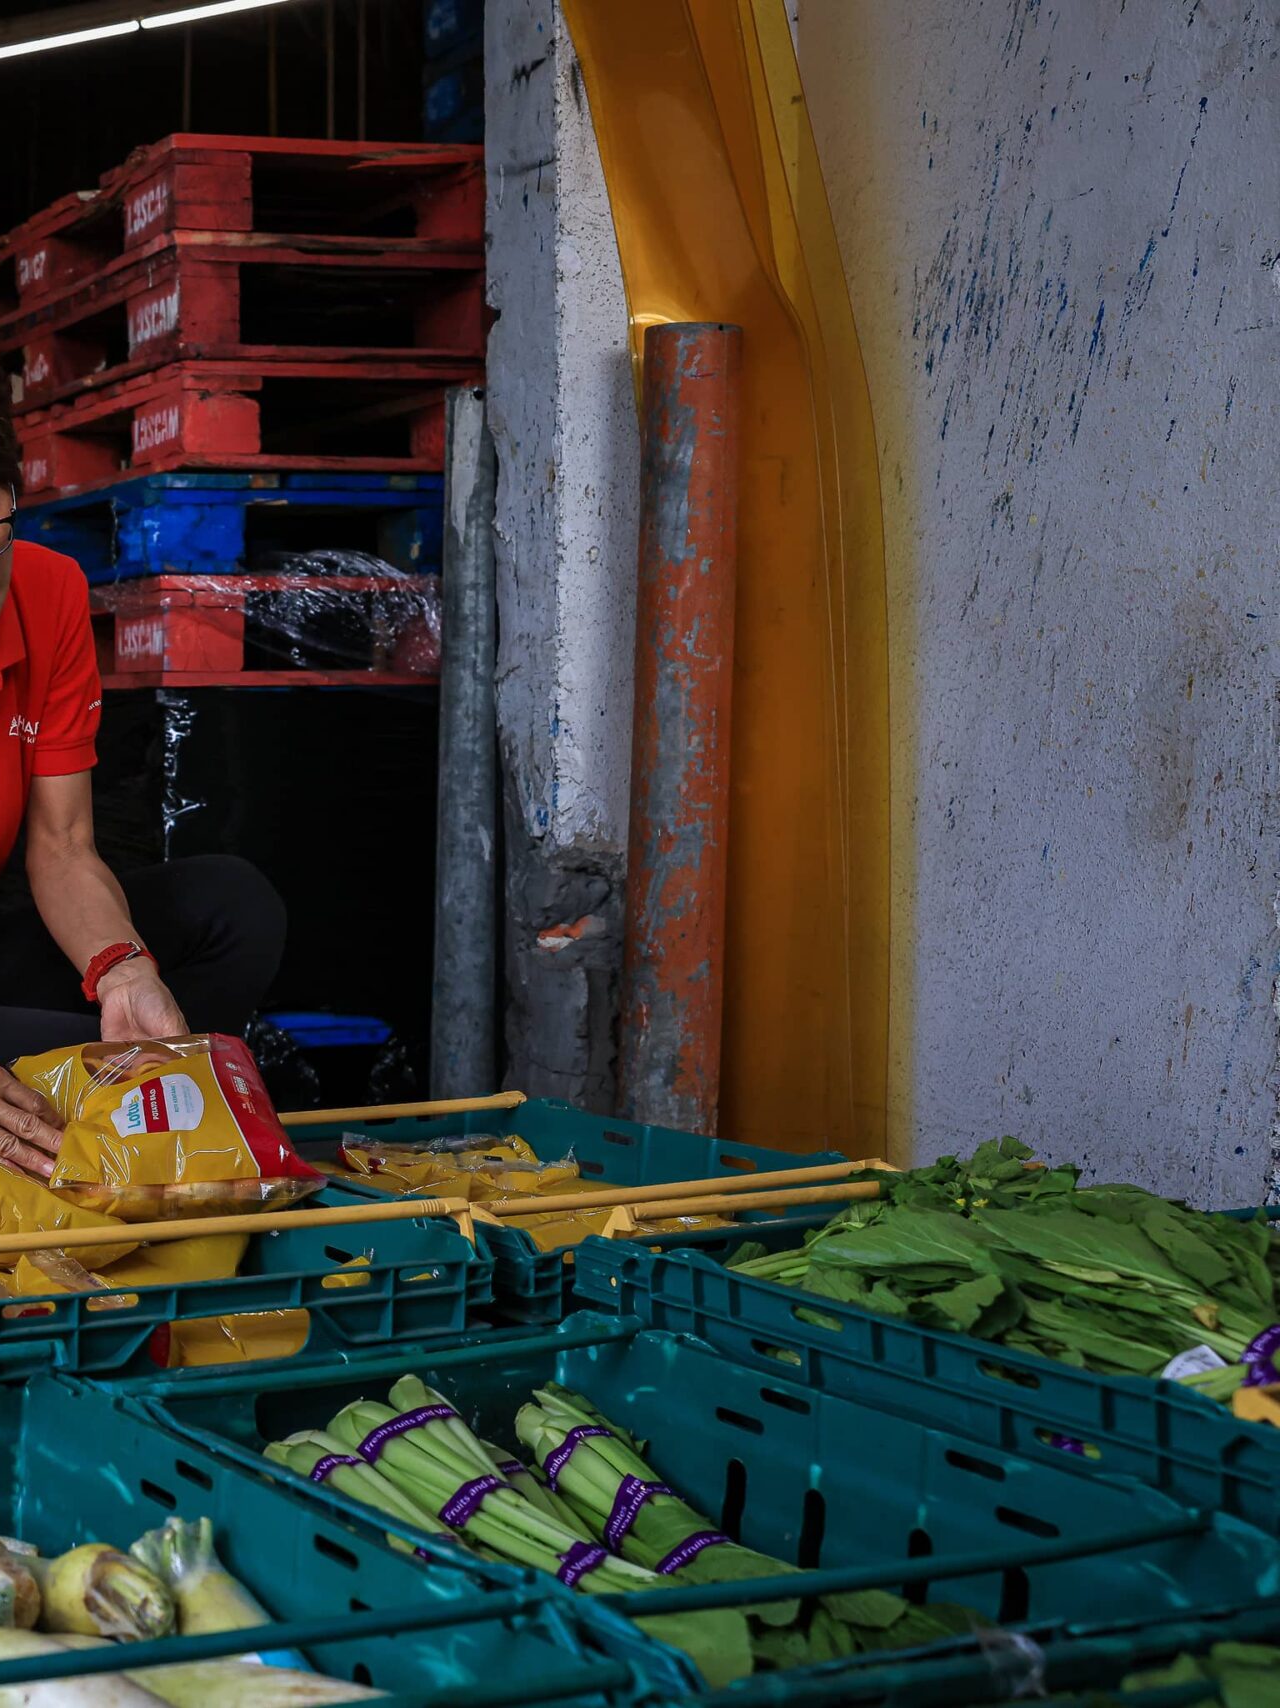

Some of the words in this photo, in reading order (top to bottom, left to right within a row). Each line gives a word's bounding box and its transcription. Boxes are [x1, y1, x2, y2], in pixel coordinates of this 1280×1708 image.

[415, 1409, 436, 1422] and
[444, 1495, 471, 1522] Fruits
[468, 1480, 489, 1497] and
[681, 1537, 711, 1558] Fruits
